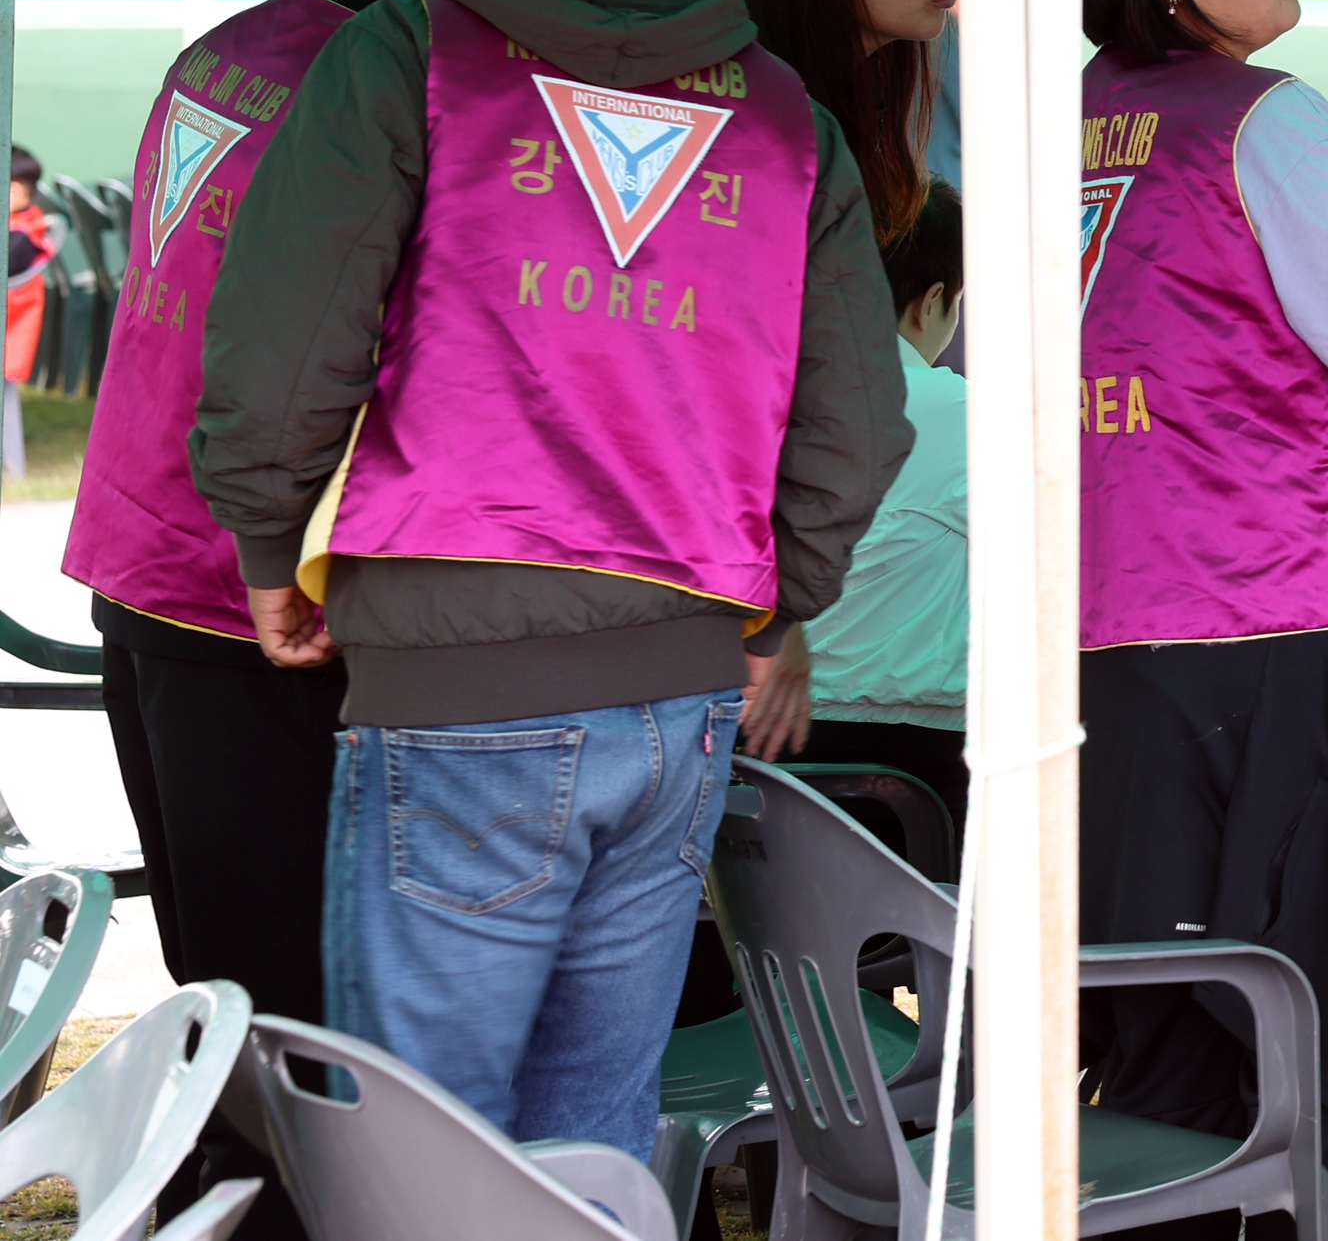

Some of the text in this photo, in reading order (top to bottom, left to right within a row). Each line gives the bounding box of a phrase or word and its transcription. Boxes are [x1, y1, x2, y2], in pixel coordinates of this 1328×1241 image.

[178, 44, 292, 123] KANG JIN CLUB
[572, 89, 696, 124] INTERNATIONAL
[674, 60, 748, 99] CLUB
[175, 105, 226, 140] INTERNATIONAL
[1104, 111, 1160, 167] CLUB
[196, 182, 235, 239] 진
[508, 137, 743, 228] 강 진
[125, 265, 188, 333] OREA
[517, 258, 697, 334] KOREA
[1081, 375, 1151, 434] REA
